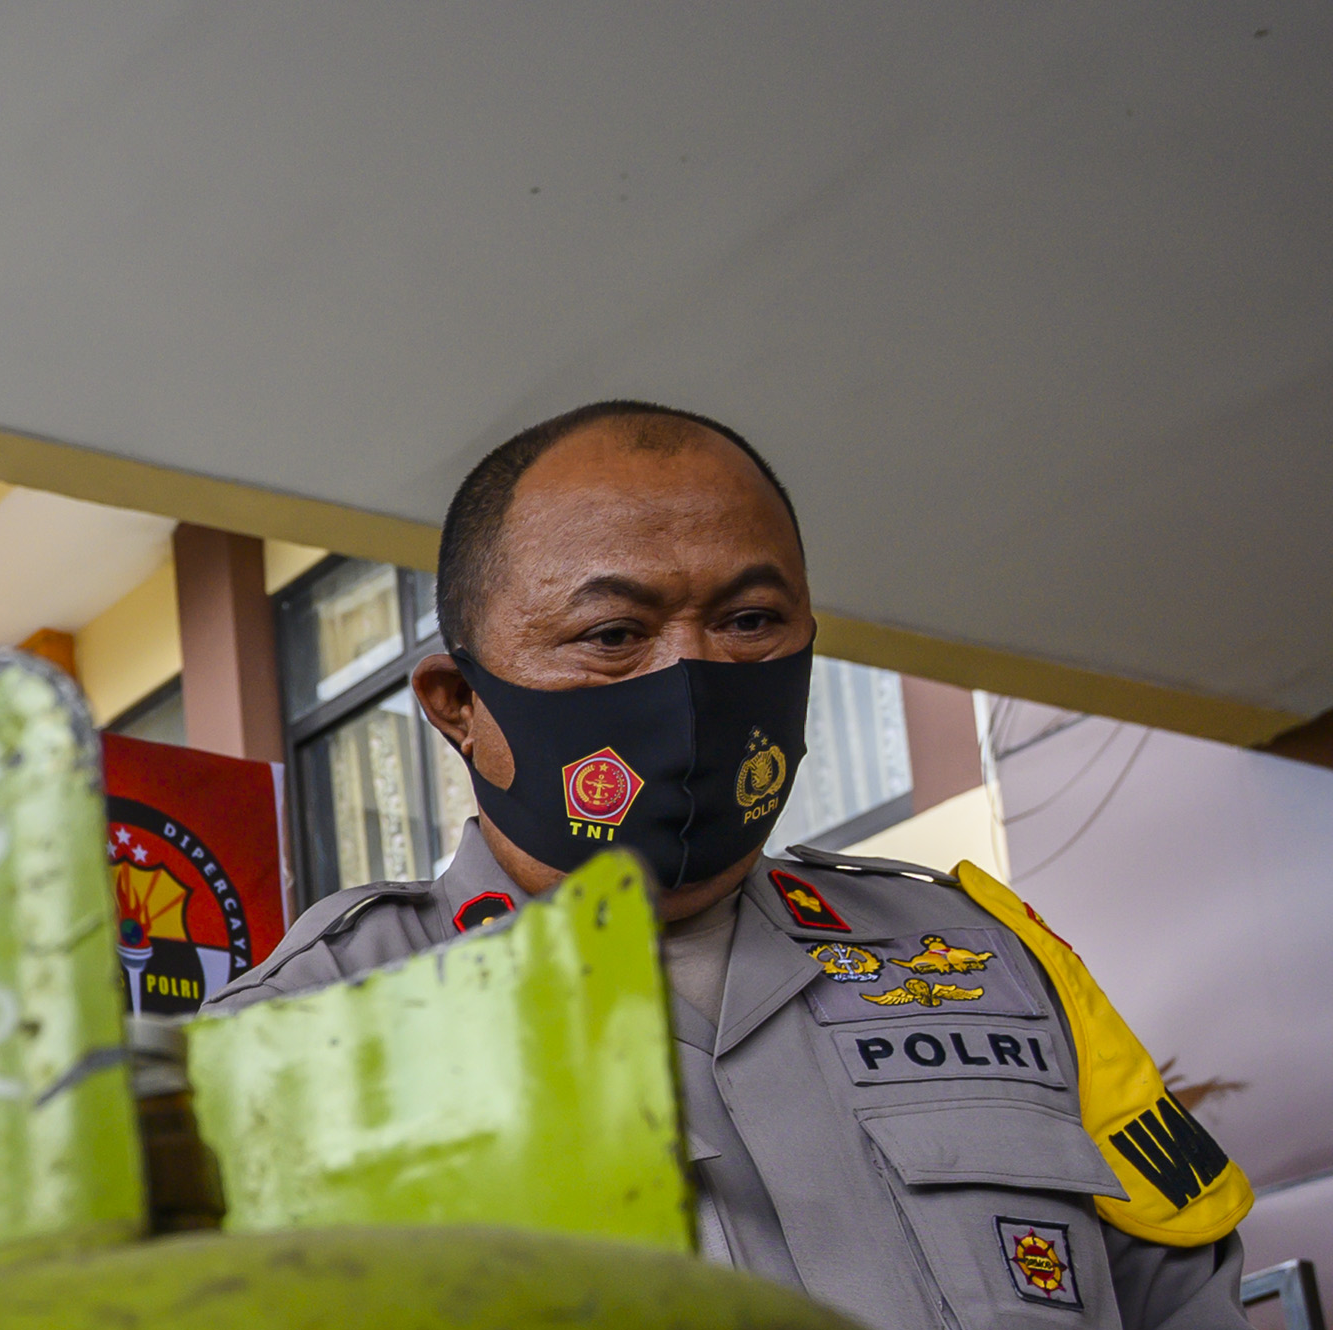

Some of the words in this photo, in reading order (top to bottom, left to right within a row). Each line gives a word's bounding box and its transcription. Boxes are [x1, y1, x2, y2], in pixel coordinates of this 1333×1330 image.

[743, 797, 779, 825] POLRI
[569, 821, 615, 842] TNI
[163, 822, 248, 968] DIPERCAYA
[145, 973, 200, 1000] POLRI
[854, 1032, 1050, 1072] POLRI
